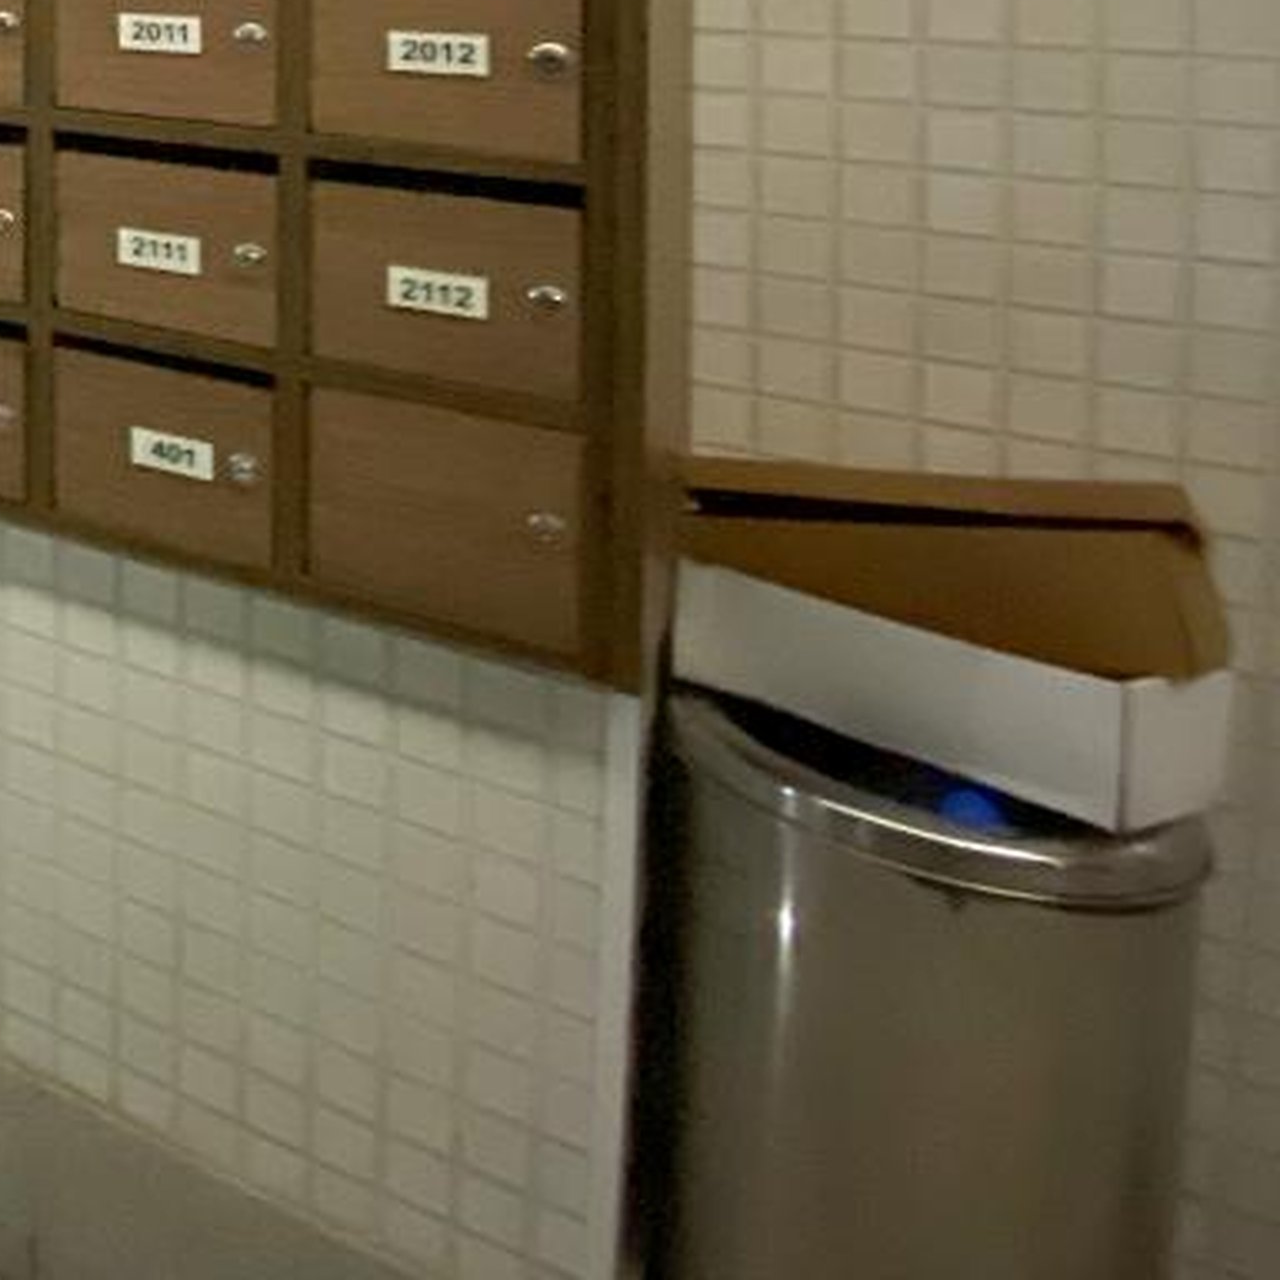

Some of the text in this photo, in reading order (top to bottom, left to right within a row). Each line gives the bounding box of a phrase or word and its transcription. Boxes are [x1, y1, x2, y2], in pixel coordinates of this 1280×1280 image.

[131, 21, 189, 44] 2011
[399, 39, 477, 66] 2012
[130, 236, 188, 263] 2111
[400, 277, 475, 309] 2112
[149, 440, 197, 469] 401
